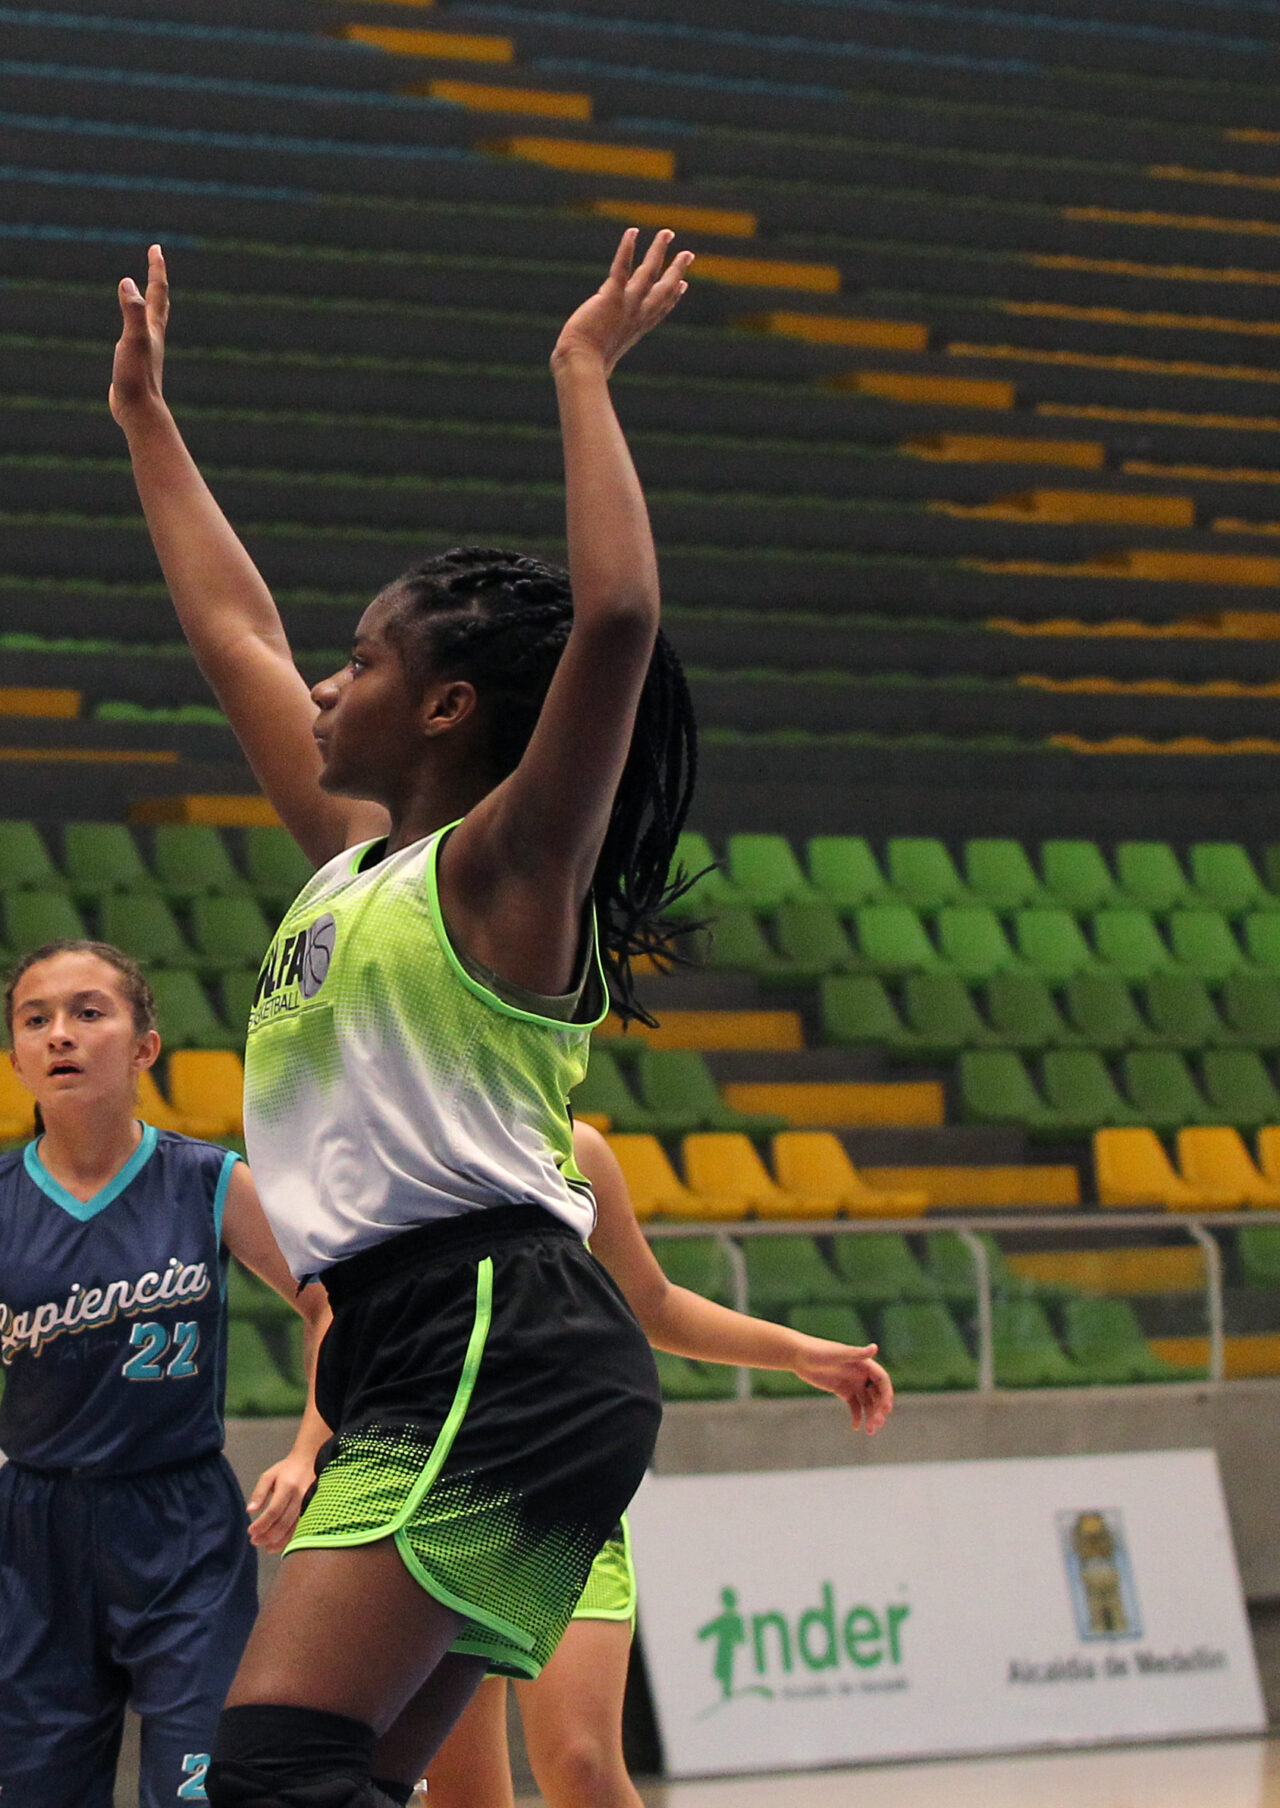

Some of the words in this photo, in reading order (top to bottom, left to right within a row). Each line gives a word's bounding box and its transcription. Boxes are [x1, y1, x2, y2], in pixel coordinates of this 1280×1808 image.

[122, 1320, 200, 1381] 22
[696, 1579, 912, 1701] inder
[177, 1753, 211, 1800] 2
